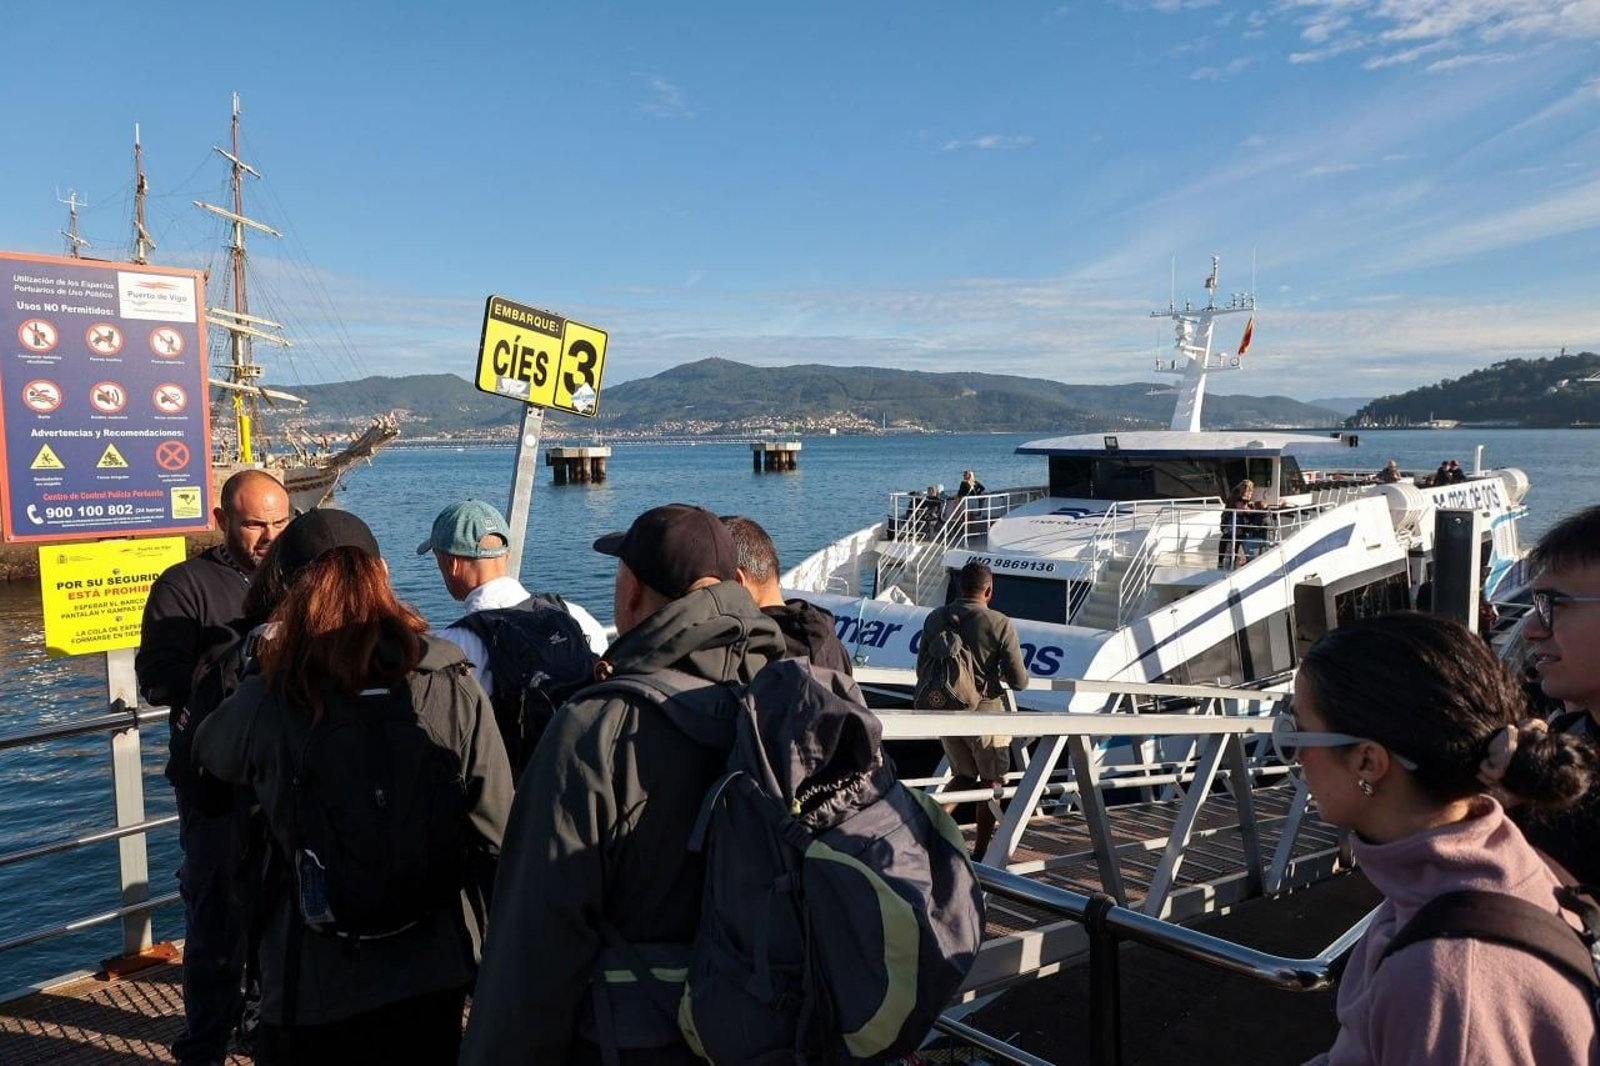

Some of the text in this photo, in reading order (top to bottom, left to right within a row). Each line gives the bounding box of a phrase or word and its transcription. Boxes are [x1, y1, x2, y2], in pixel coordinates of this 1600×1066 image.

[14, 284, 55, 295] Portuarios
[68, 289, 83, 297] Uso
[56, 278, 65, 286] de
[67, 279, 79, 287] los
[81, 280, 114, 290] Espacios
[127, 290, 188, 303] Puerto de Vigo
[16, 301, 114, 316] Usos NO Permitidos:
[494, 303, 560, 333] EMBARQUE:
[493, 334, 549, 387] CÍES
[564, 339, 597, 397] 3
[31, 428, 93, 438] Advertencias
[103, 428, 185, 438] Recomendaciones:
[43, 492, 68, 501] Centro
[69, 492, 79, 500] de
[45, 507, 73, 519] 900
[77, 505, 104, 517] 100
[108, 504, 133, 516] 802
[993, 558, 1056, 573] 9869136
[57, 580, 82, 590] POR
[87, 579, 103, 588] SU
[74, 601, 108, 611] ESPERAR
[121, 598, 145, 606] BARCO
[107, 605, 136, 614] RAMPAS
[835, 615, 903, 648] mar
